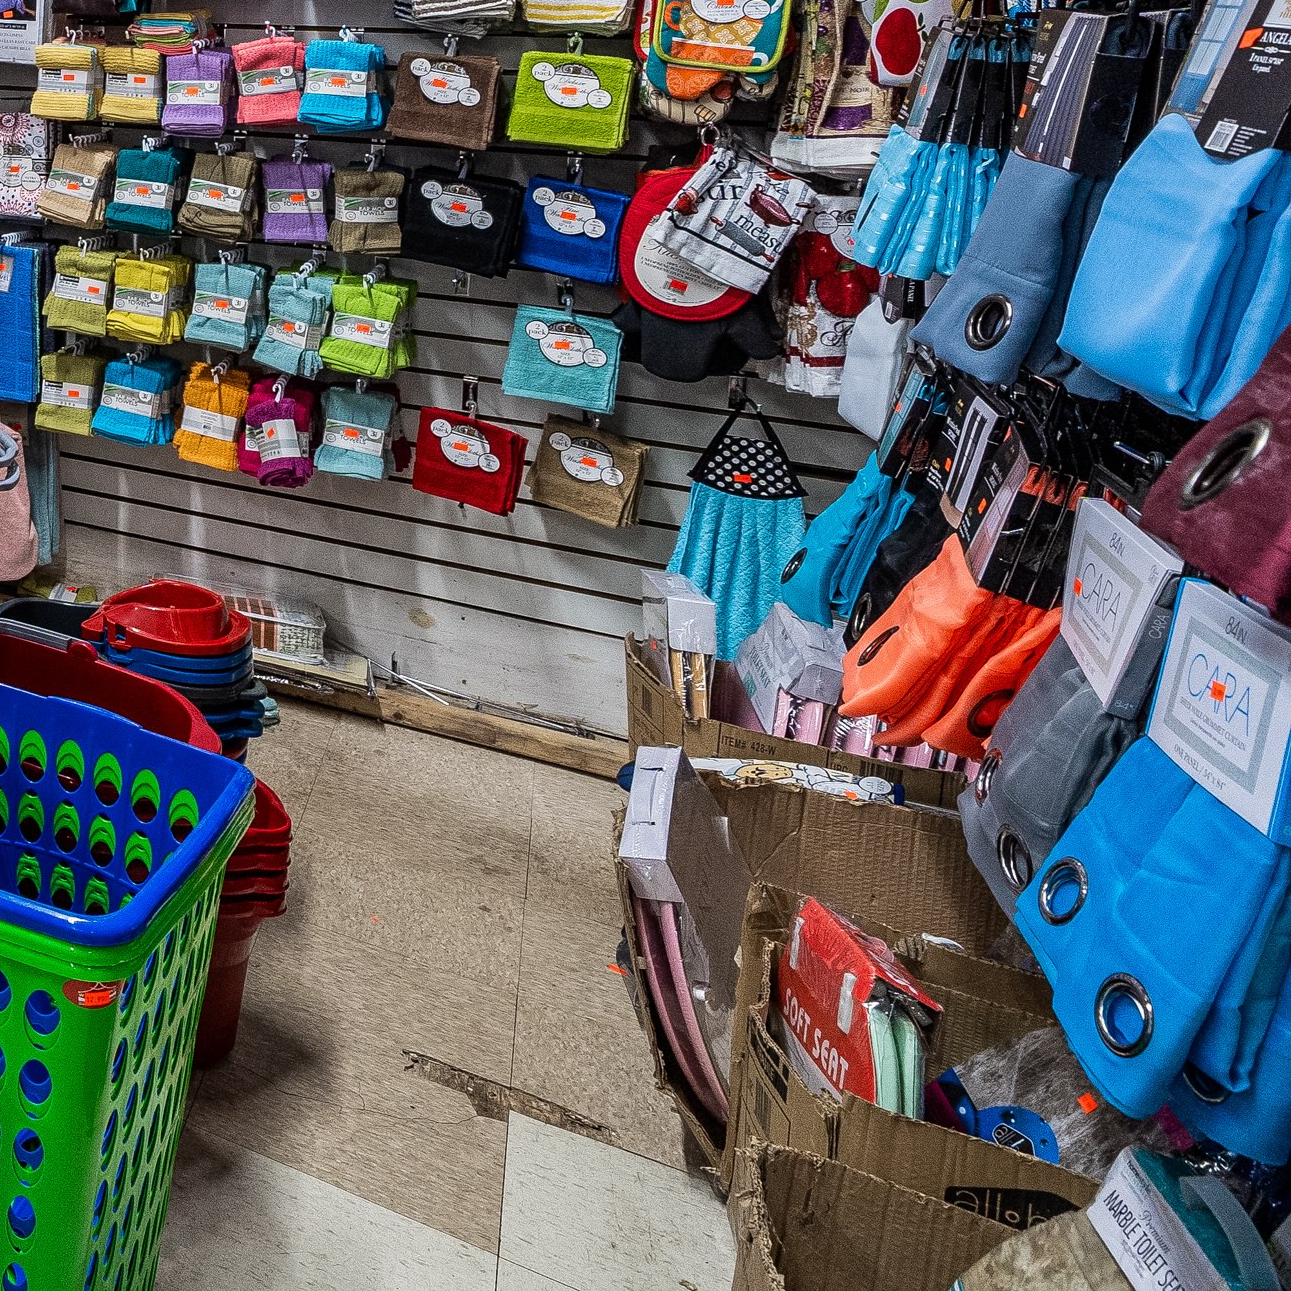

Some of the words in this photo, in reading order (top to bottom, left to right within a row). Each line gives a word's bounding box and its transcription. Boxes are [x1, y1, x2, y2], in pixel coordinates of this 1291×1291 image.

[1081, 560, 1120, 633] CARA
[783, 988, 813, 1039] SOFT
[811, 1028, 850, 1090] SEAT
[1102, 1187, 1141, 1233] MARBLE
[1124, 1228, 1166, 1277] TOILET
